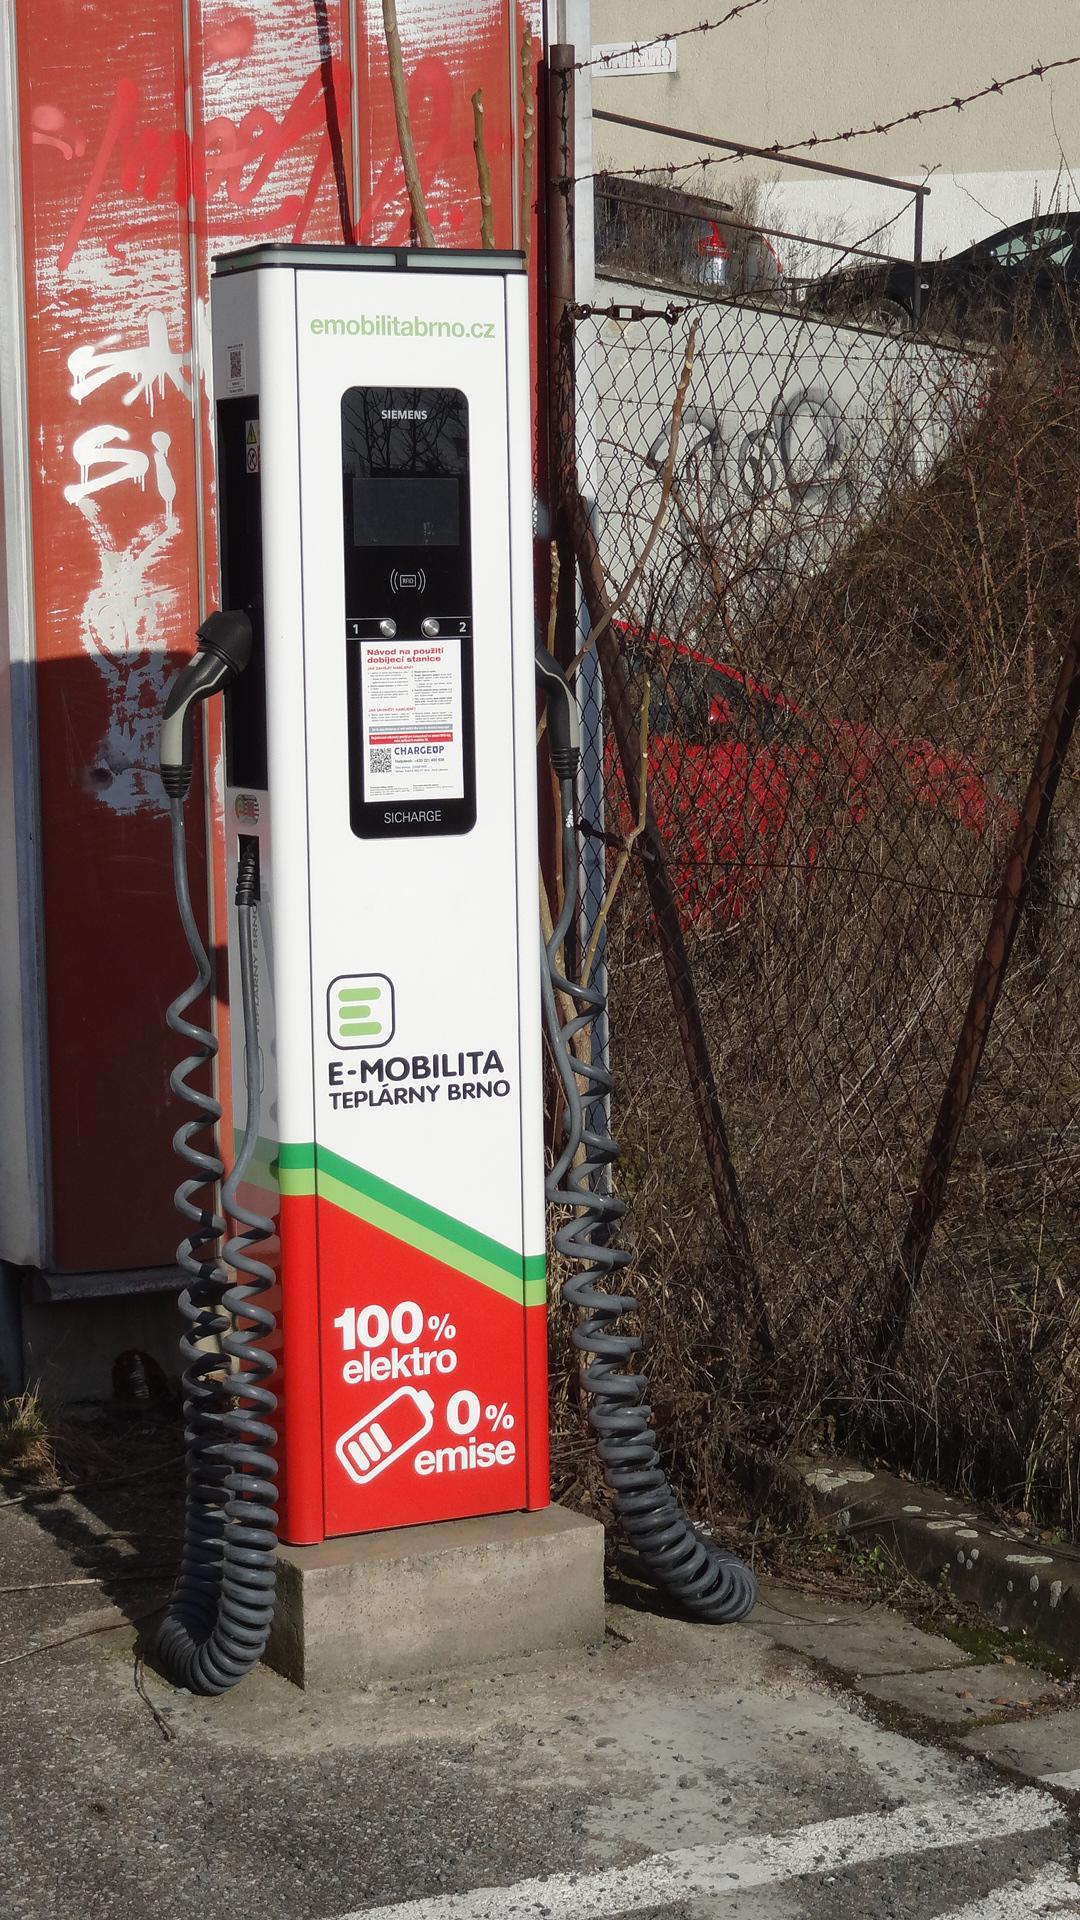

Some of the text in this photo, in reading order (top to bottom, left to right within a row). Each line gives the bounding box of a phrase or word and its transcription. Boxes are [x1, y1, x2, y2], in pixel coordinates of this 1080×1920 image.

[310, 315, 496, 339] emobilitabrno.cz
[381, 410, 428, 420] SIEMENS
[353, 623, 359, 635] 1
[458, 622, 467, 632] 2
[367, 648, 396, 656] Návod
[413, 647, 444, 656] použití
[367, 655, 441, 664] dobíjecí stanice
[394, 745, 445, 755] CHARGEUP
[384, 810, 442, 825] SICHARGE
[329, 1049, 504, 1086] E-MOBILITA
[329, 1079, 511, 1110] TEPLÁRNY BRNO
[342, 1347, 458, 1385] elektro
[414, 1436, 516, 1476] emise
